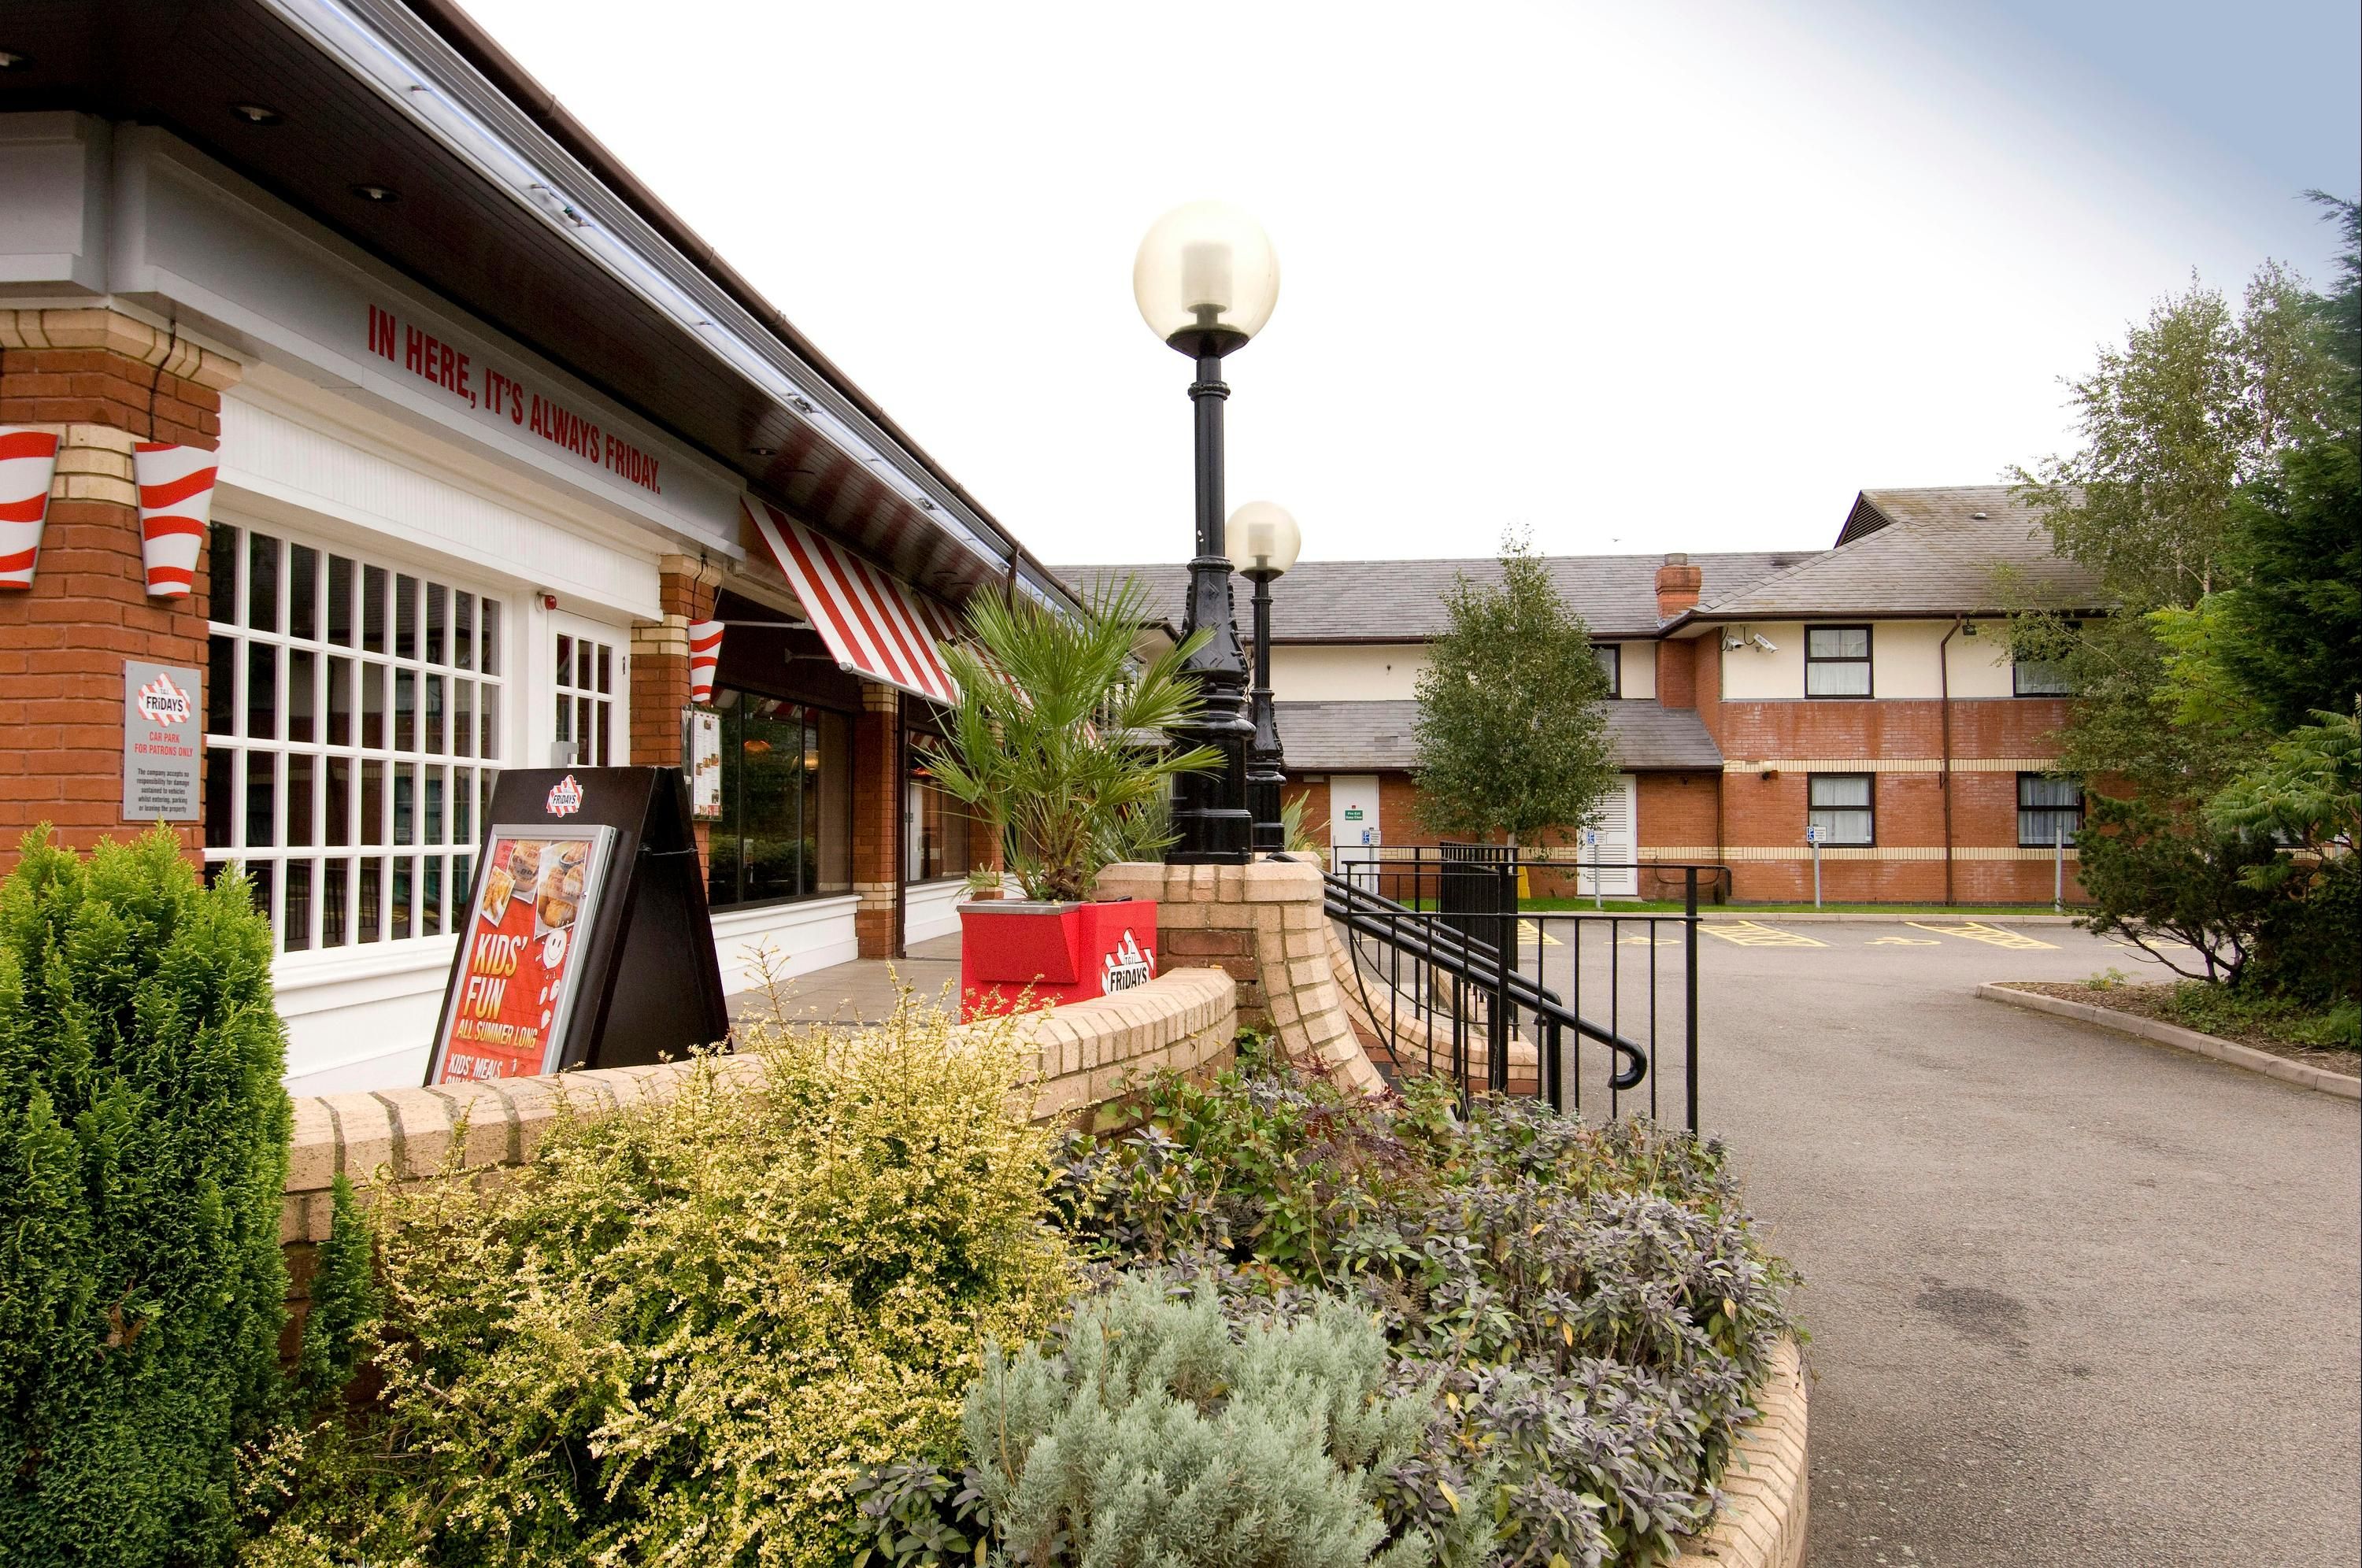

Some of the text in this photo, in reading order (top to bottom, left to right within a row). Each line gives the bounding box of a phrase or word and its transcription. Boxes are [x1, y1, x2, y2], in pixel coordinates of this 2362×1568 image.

[368, 303, 661, 495] IN HERE, IT'S ALWAYS FRIDAY.
[135, 742, 194, 757] FOR PATRONS ONLY
[150, 730, 180, 744] CAR PARK
[136, 778, 166, 786] responsibility
[472, 933, 529, 977] KIDS'
[463, 976, 507, 1020] FUN
[456, 1018, 539, 1049] ALL SUMMER LONG
[447, 1053, 503, 1079] KIDS' MEALS
